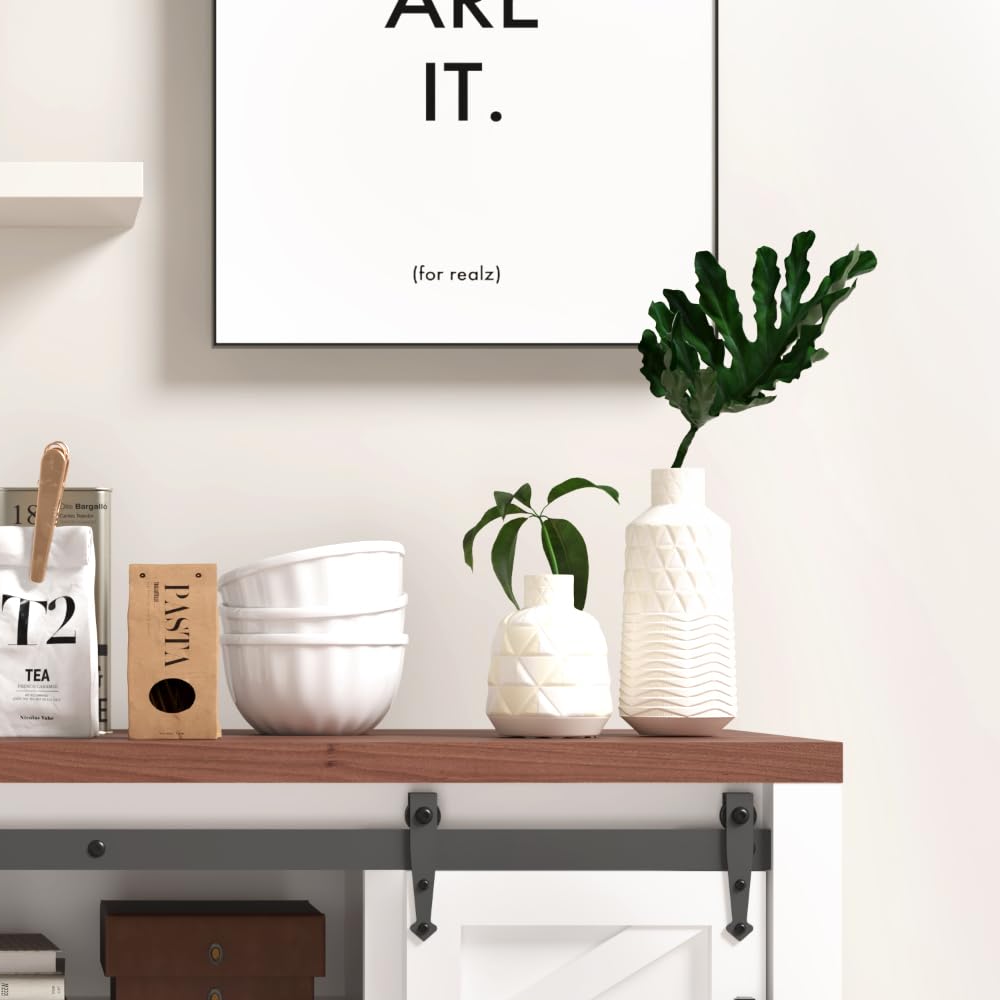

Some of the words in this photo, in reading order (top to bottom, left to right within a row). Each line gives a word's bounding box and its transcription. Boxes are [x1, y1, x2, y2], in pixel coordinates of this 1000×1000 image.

[425, 62, 503, 123] IT.
[413, 264, 444, 285] (for
[450, 264, 501, 285] realz)
[1, 594, 77, 646] T2
[164, 584, 190, 668] PASTA
[24, 668, 51, 682] TEA
